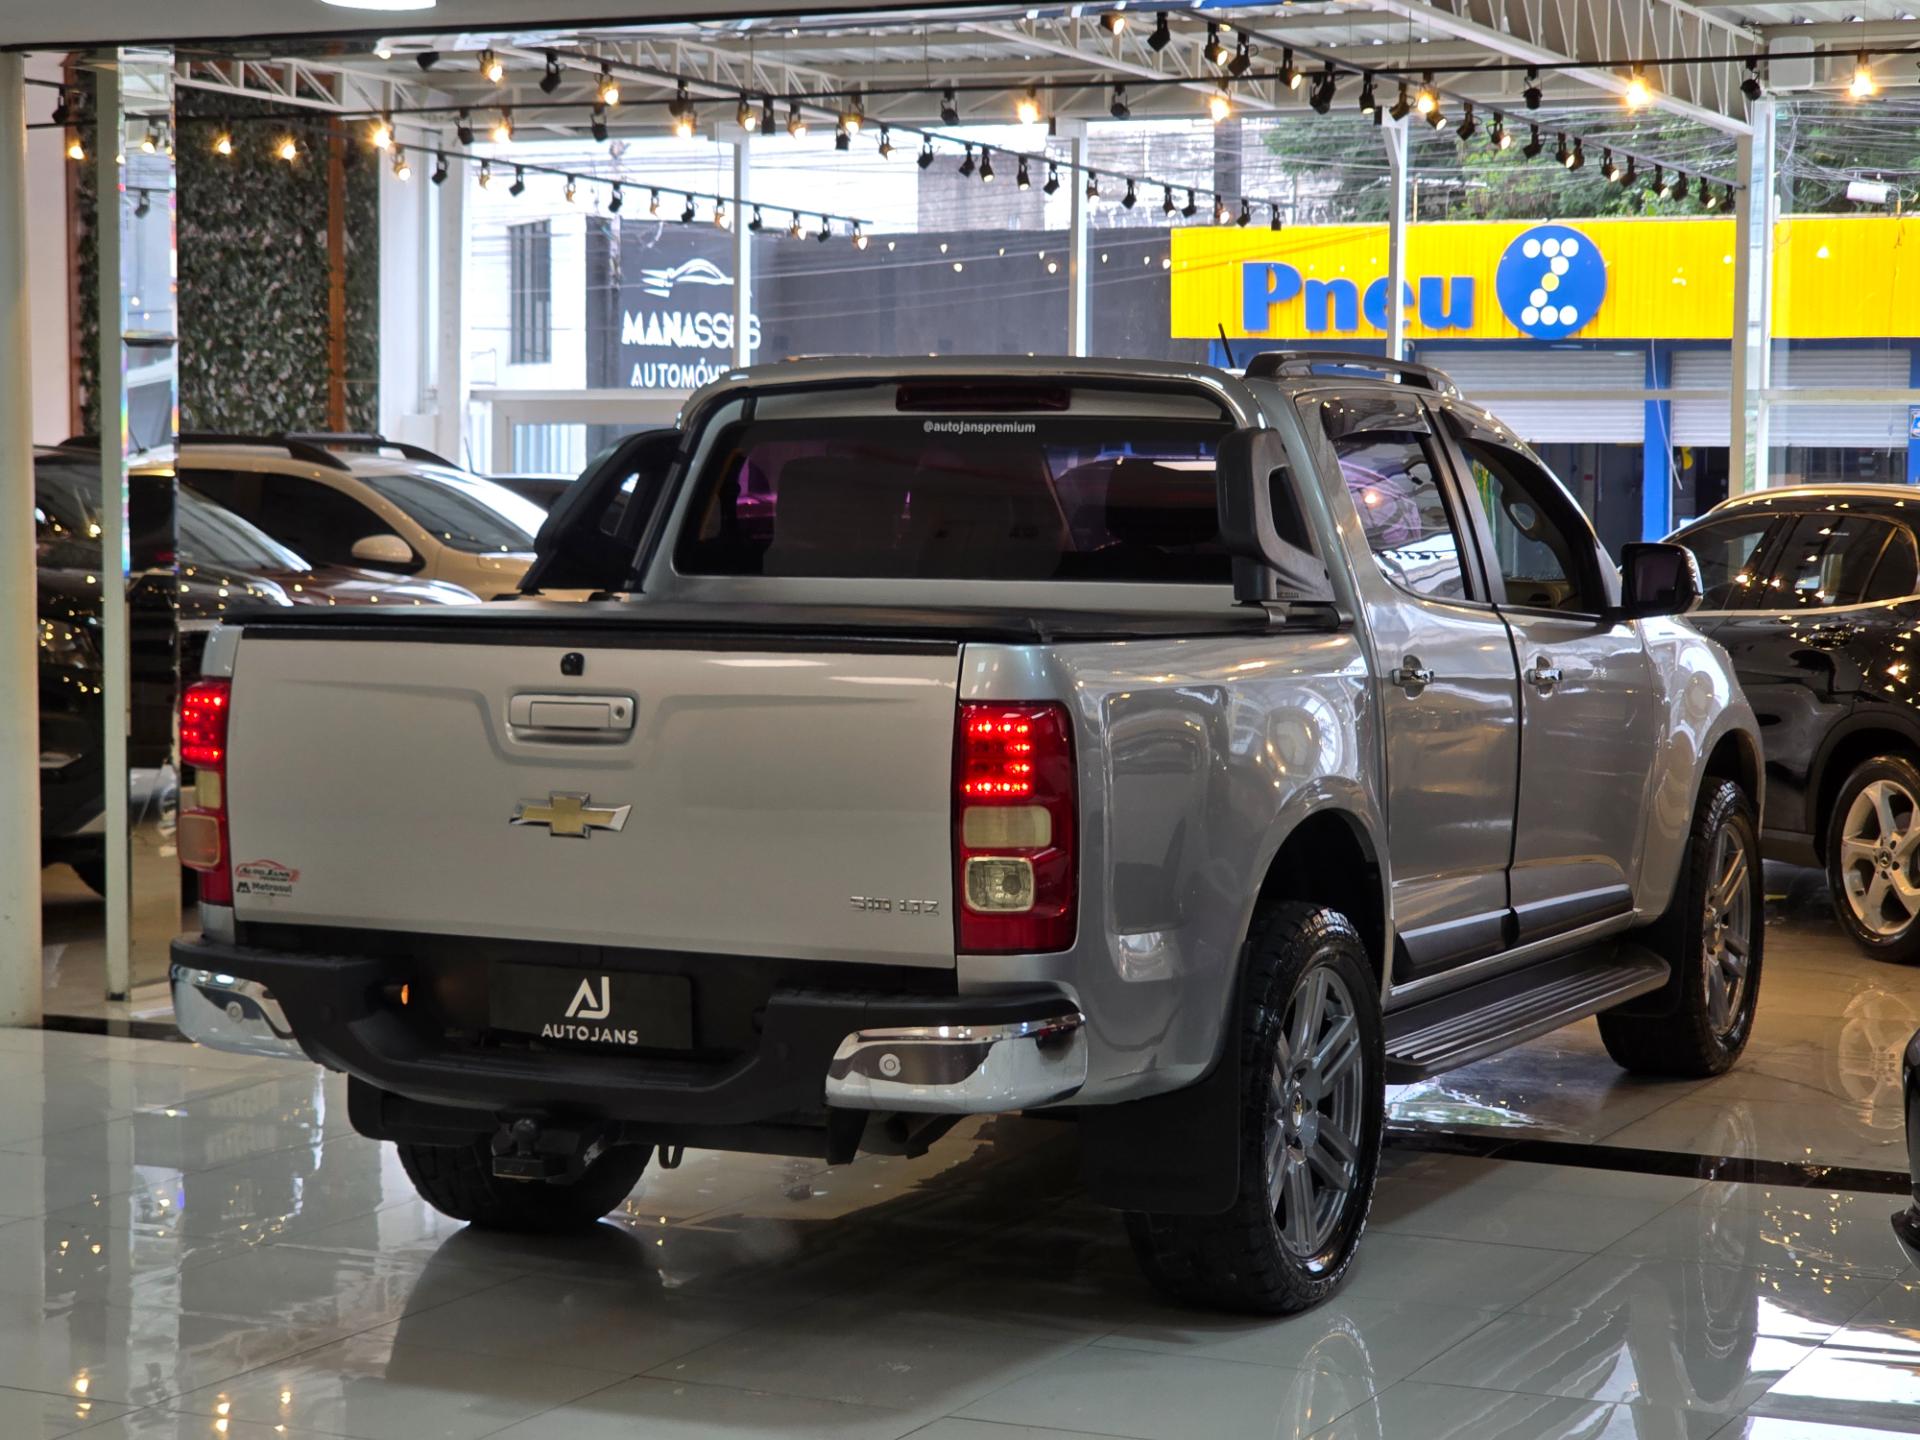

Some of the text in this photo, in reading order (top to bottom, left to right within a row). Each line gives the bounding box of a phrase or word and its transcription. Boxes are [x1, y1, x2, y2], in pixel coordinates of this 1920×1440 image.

[621, 310, 761, 350] MANASSS
[923, 420, 1037, 435] @autojanspremium
[541, 1023, 639, 1046] AUTOJANS
